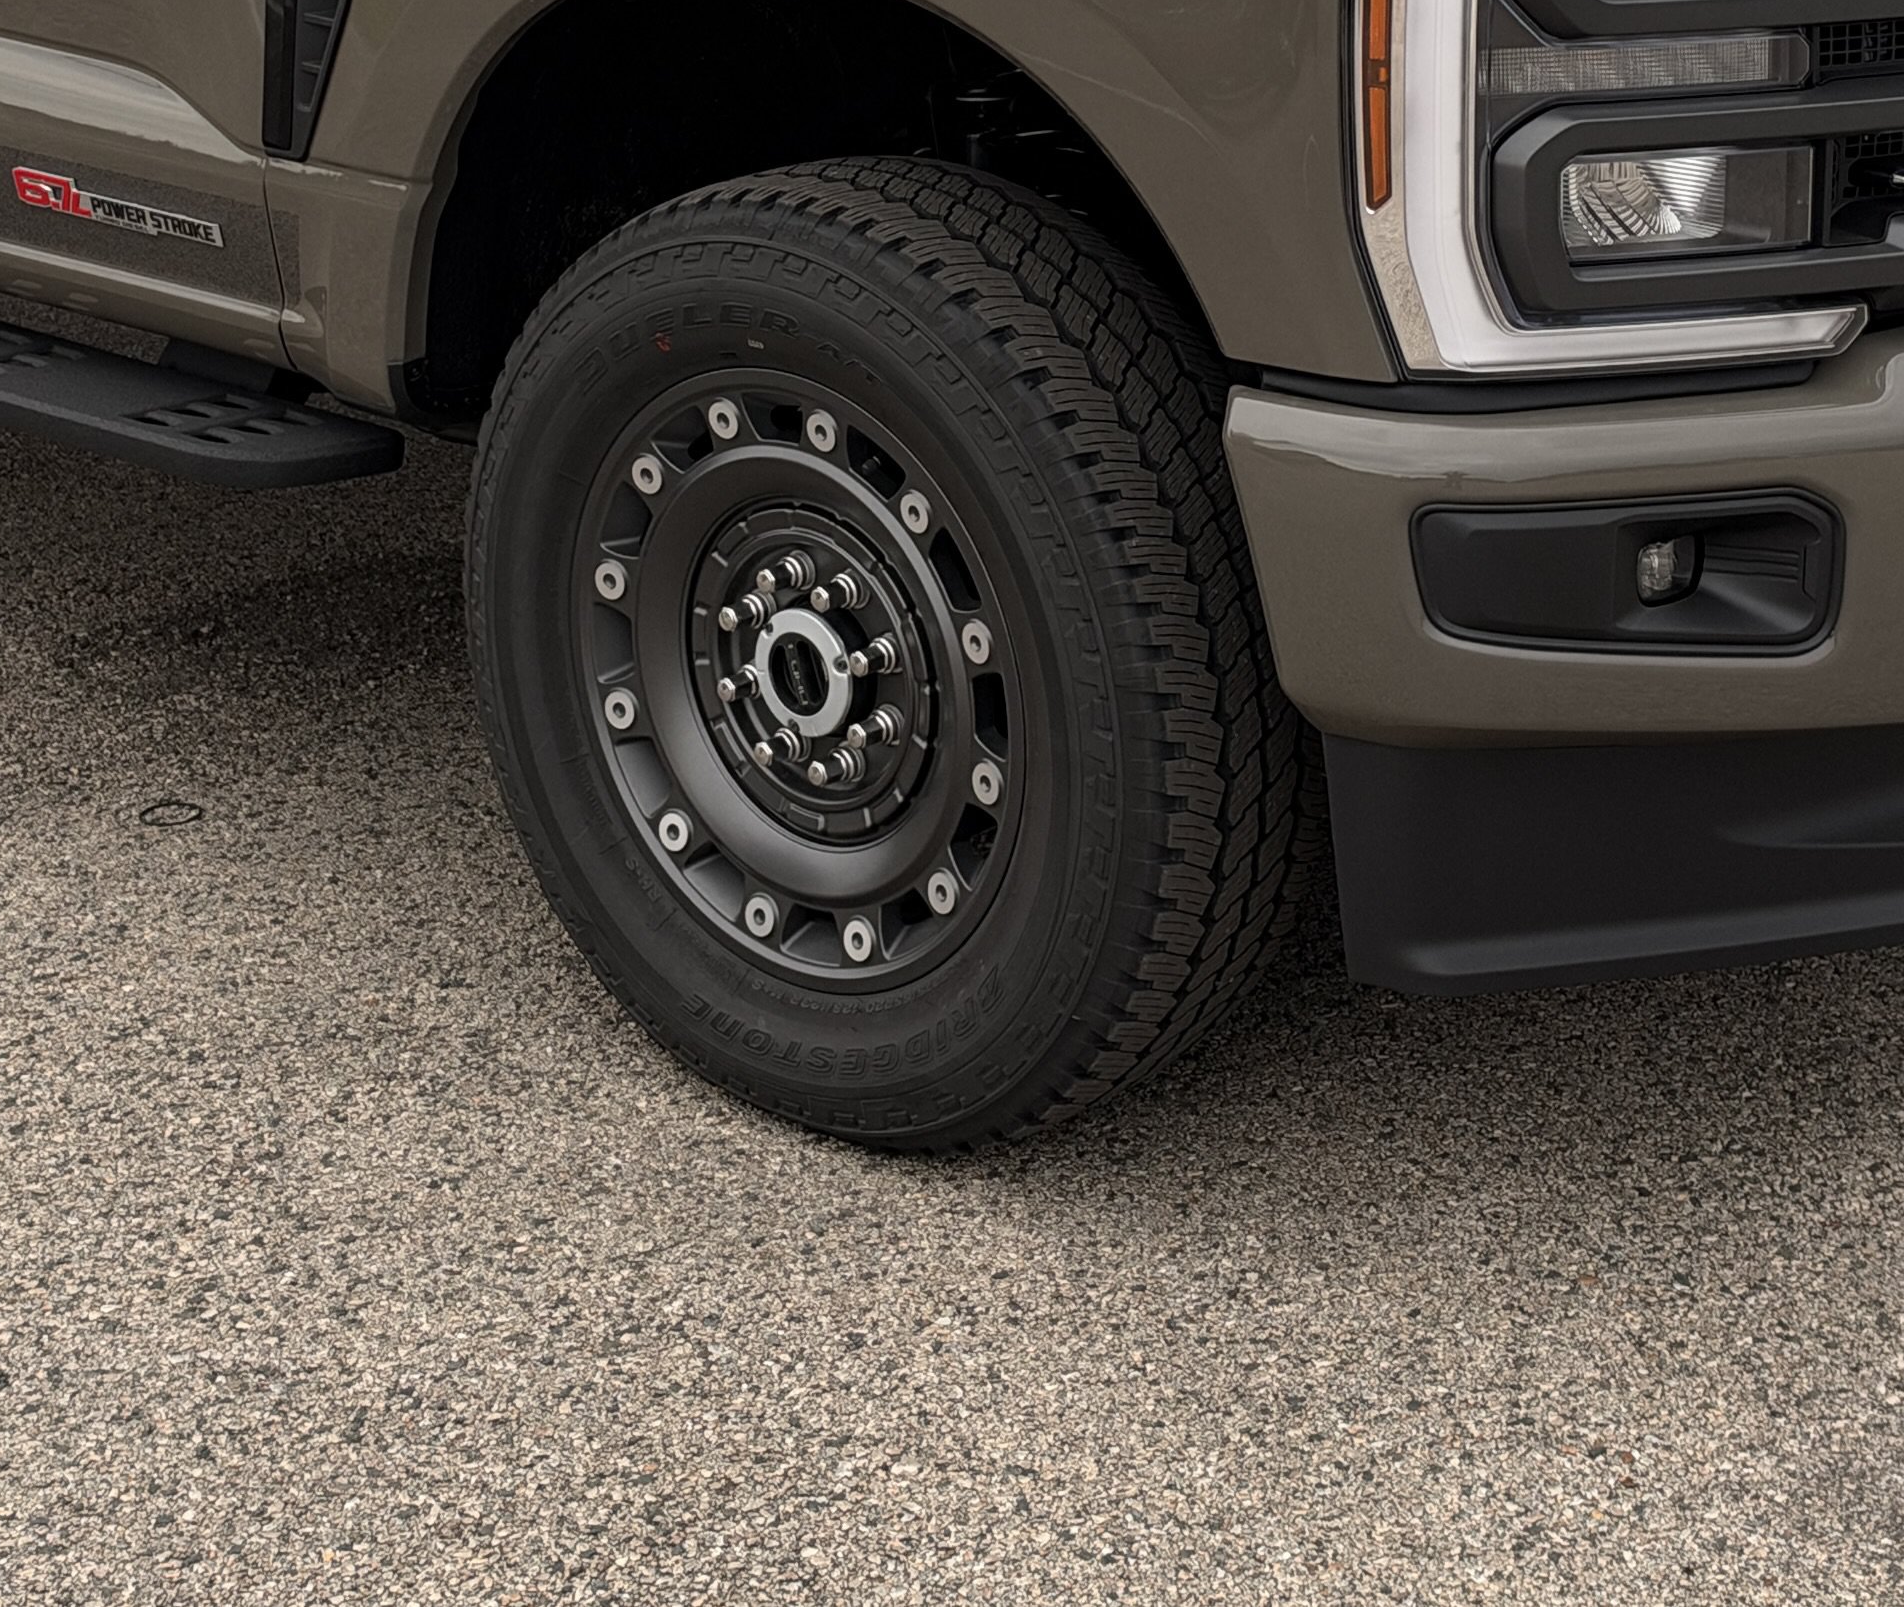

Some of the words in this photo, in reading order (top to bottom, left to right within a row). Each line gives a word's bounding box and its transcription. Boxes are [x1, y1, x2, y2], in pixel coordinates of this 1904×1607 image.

[11, 166, 92, 219] 6.7L
[90, 196, 147, 225] POWER
[149, 210, 217, 245] STROKE
[574, 300, 801, 394] DUELER
[679, 967, 1009, 1078] BRIDGESTONE
